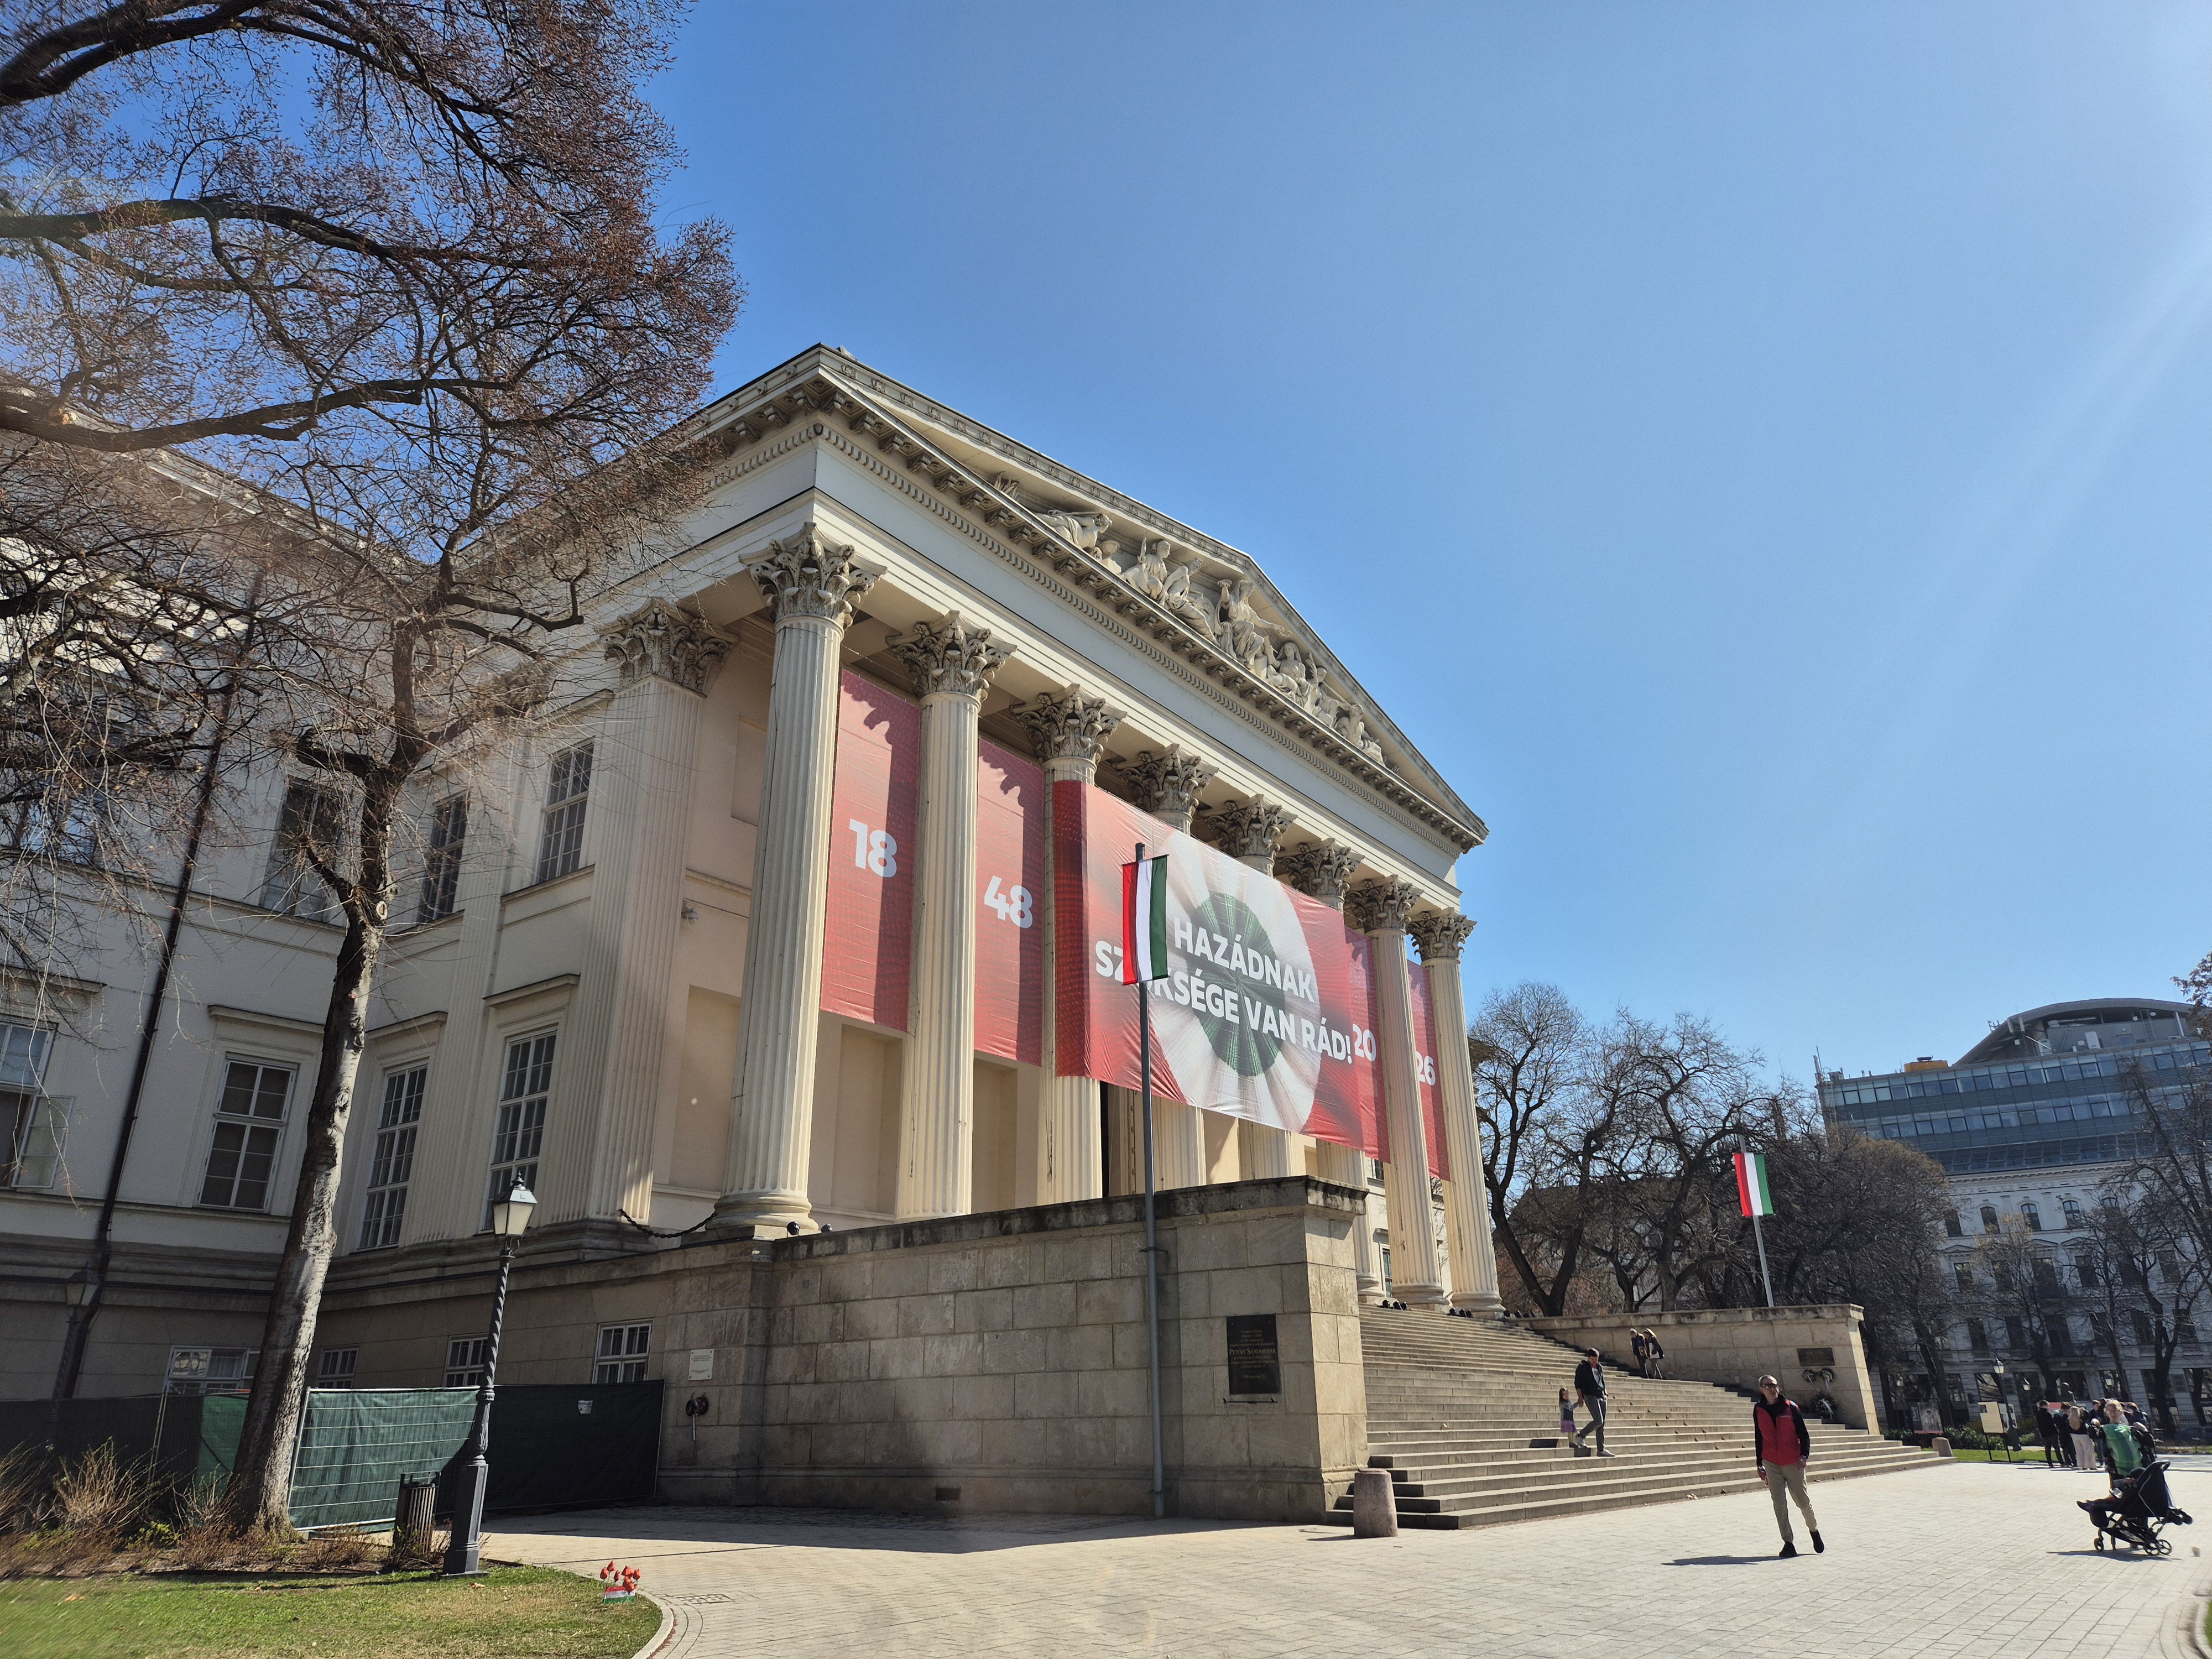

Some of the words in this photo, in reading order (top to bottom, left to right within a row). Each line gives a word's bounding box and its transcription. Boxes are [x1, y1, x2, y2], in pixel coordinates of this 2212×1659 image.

[849, 818, 898, 878] 18
[984, 875, 1033, 928] 48
[1173, 916, 1315, 1003] HAZÁDNAK
[1095, 940, 1240, 1024] SZKSÉGE
[1244, 995, 1296, 1044] VAN
[1301, 1016, 1353, 1065] RÁD!
[1352, 1023, 1377, 1062] 20
[1416, 1051, 1436, 1086] 26
